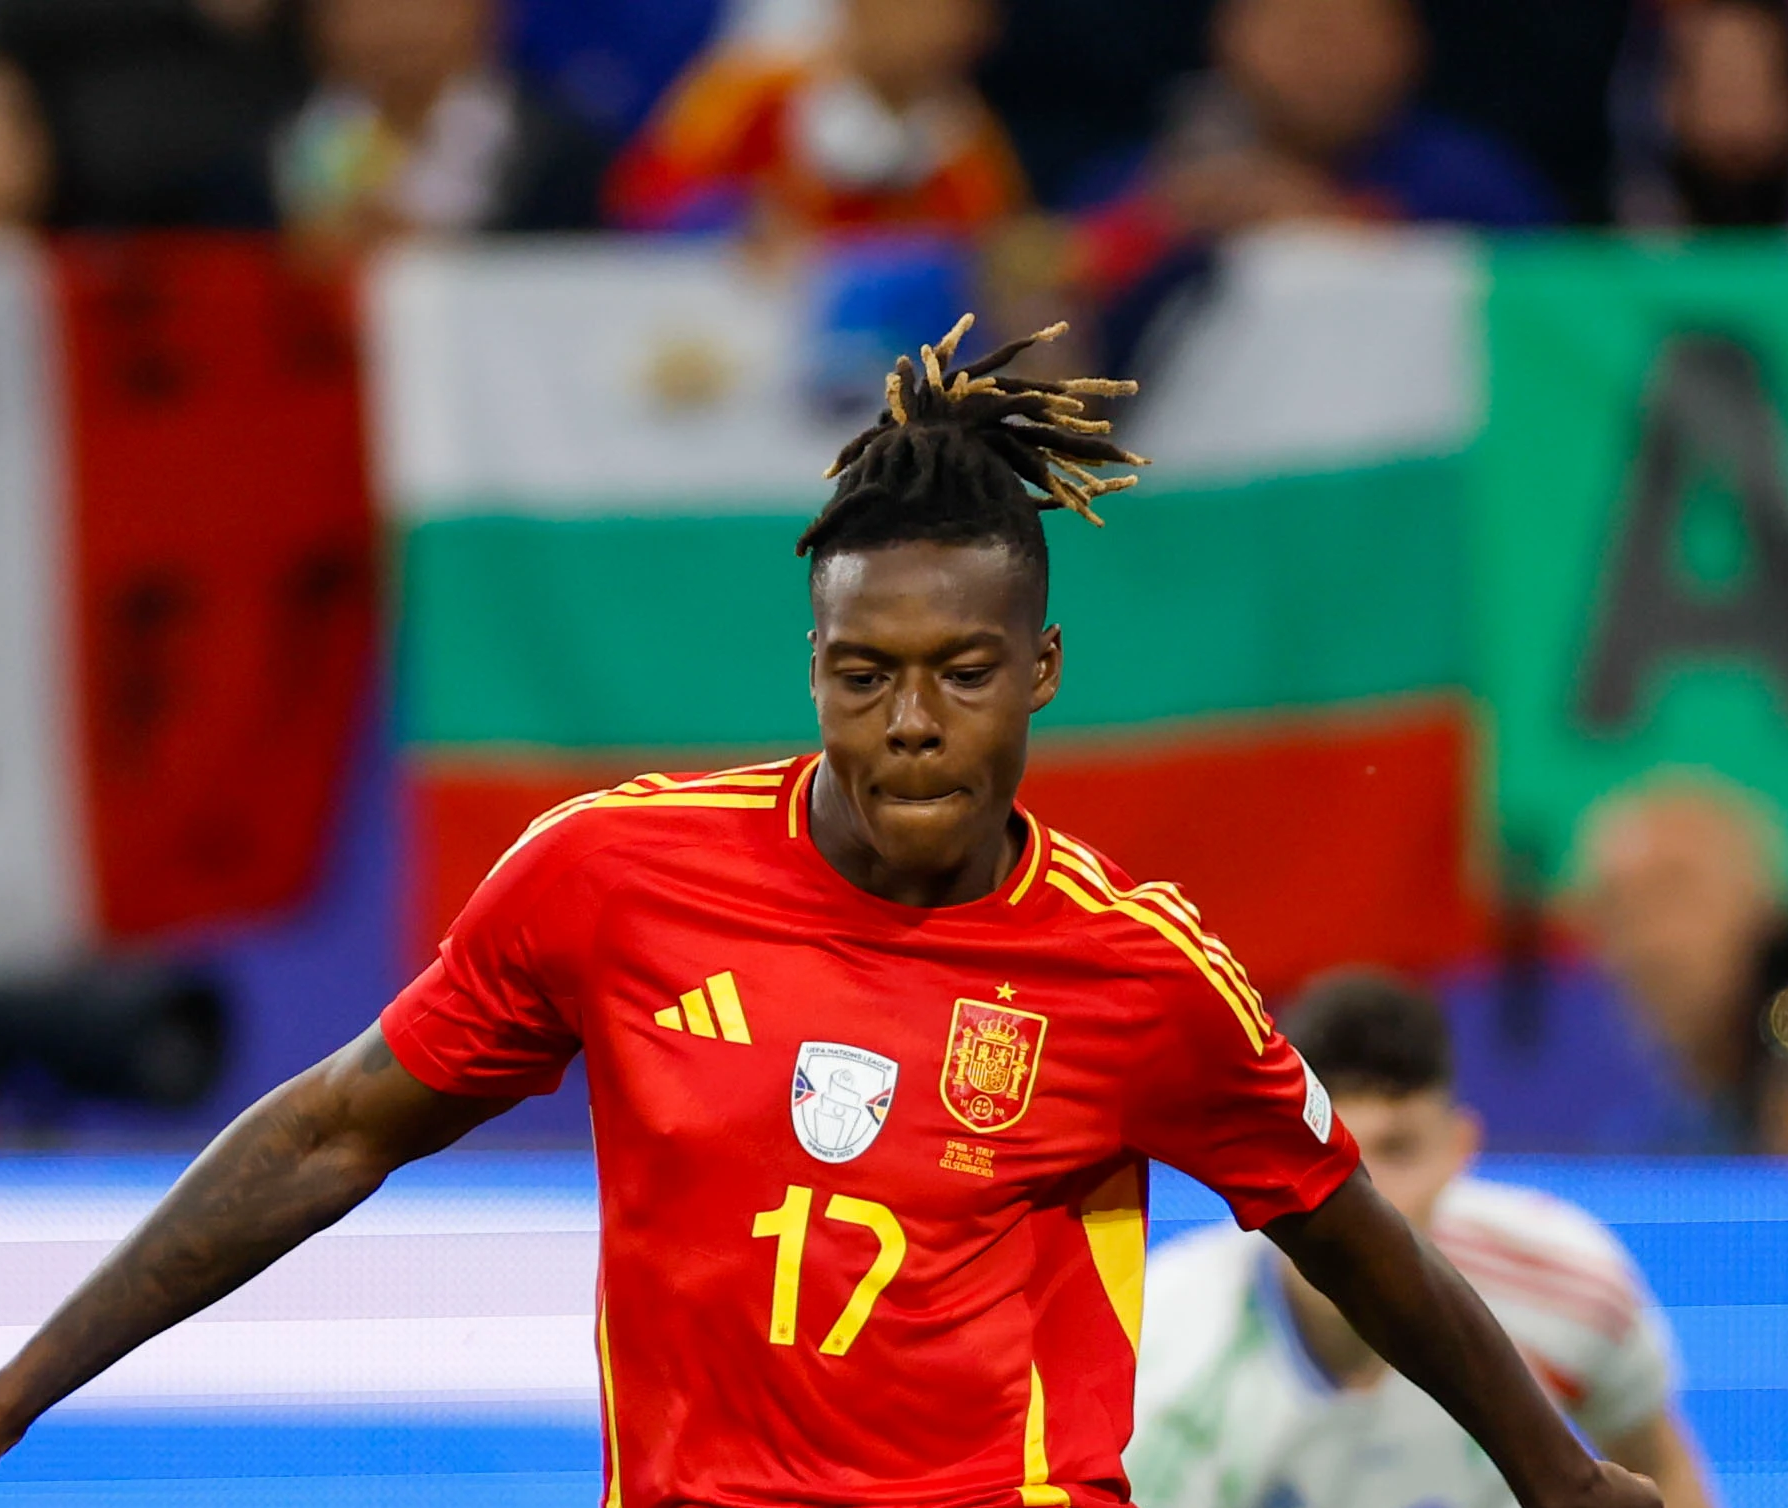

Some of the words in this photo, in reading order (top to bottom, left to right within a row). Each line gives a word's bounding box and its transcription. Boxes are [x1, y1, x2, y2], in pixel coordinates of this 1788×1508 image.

[805, 1046, 826, 1054] UEFA
[827, 1048, 862, 1060] NATIONS
[863, 1055, 893, 1071] LEAGUE
[751, 1183, 908, 1357] 17
